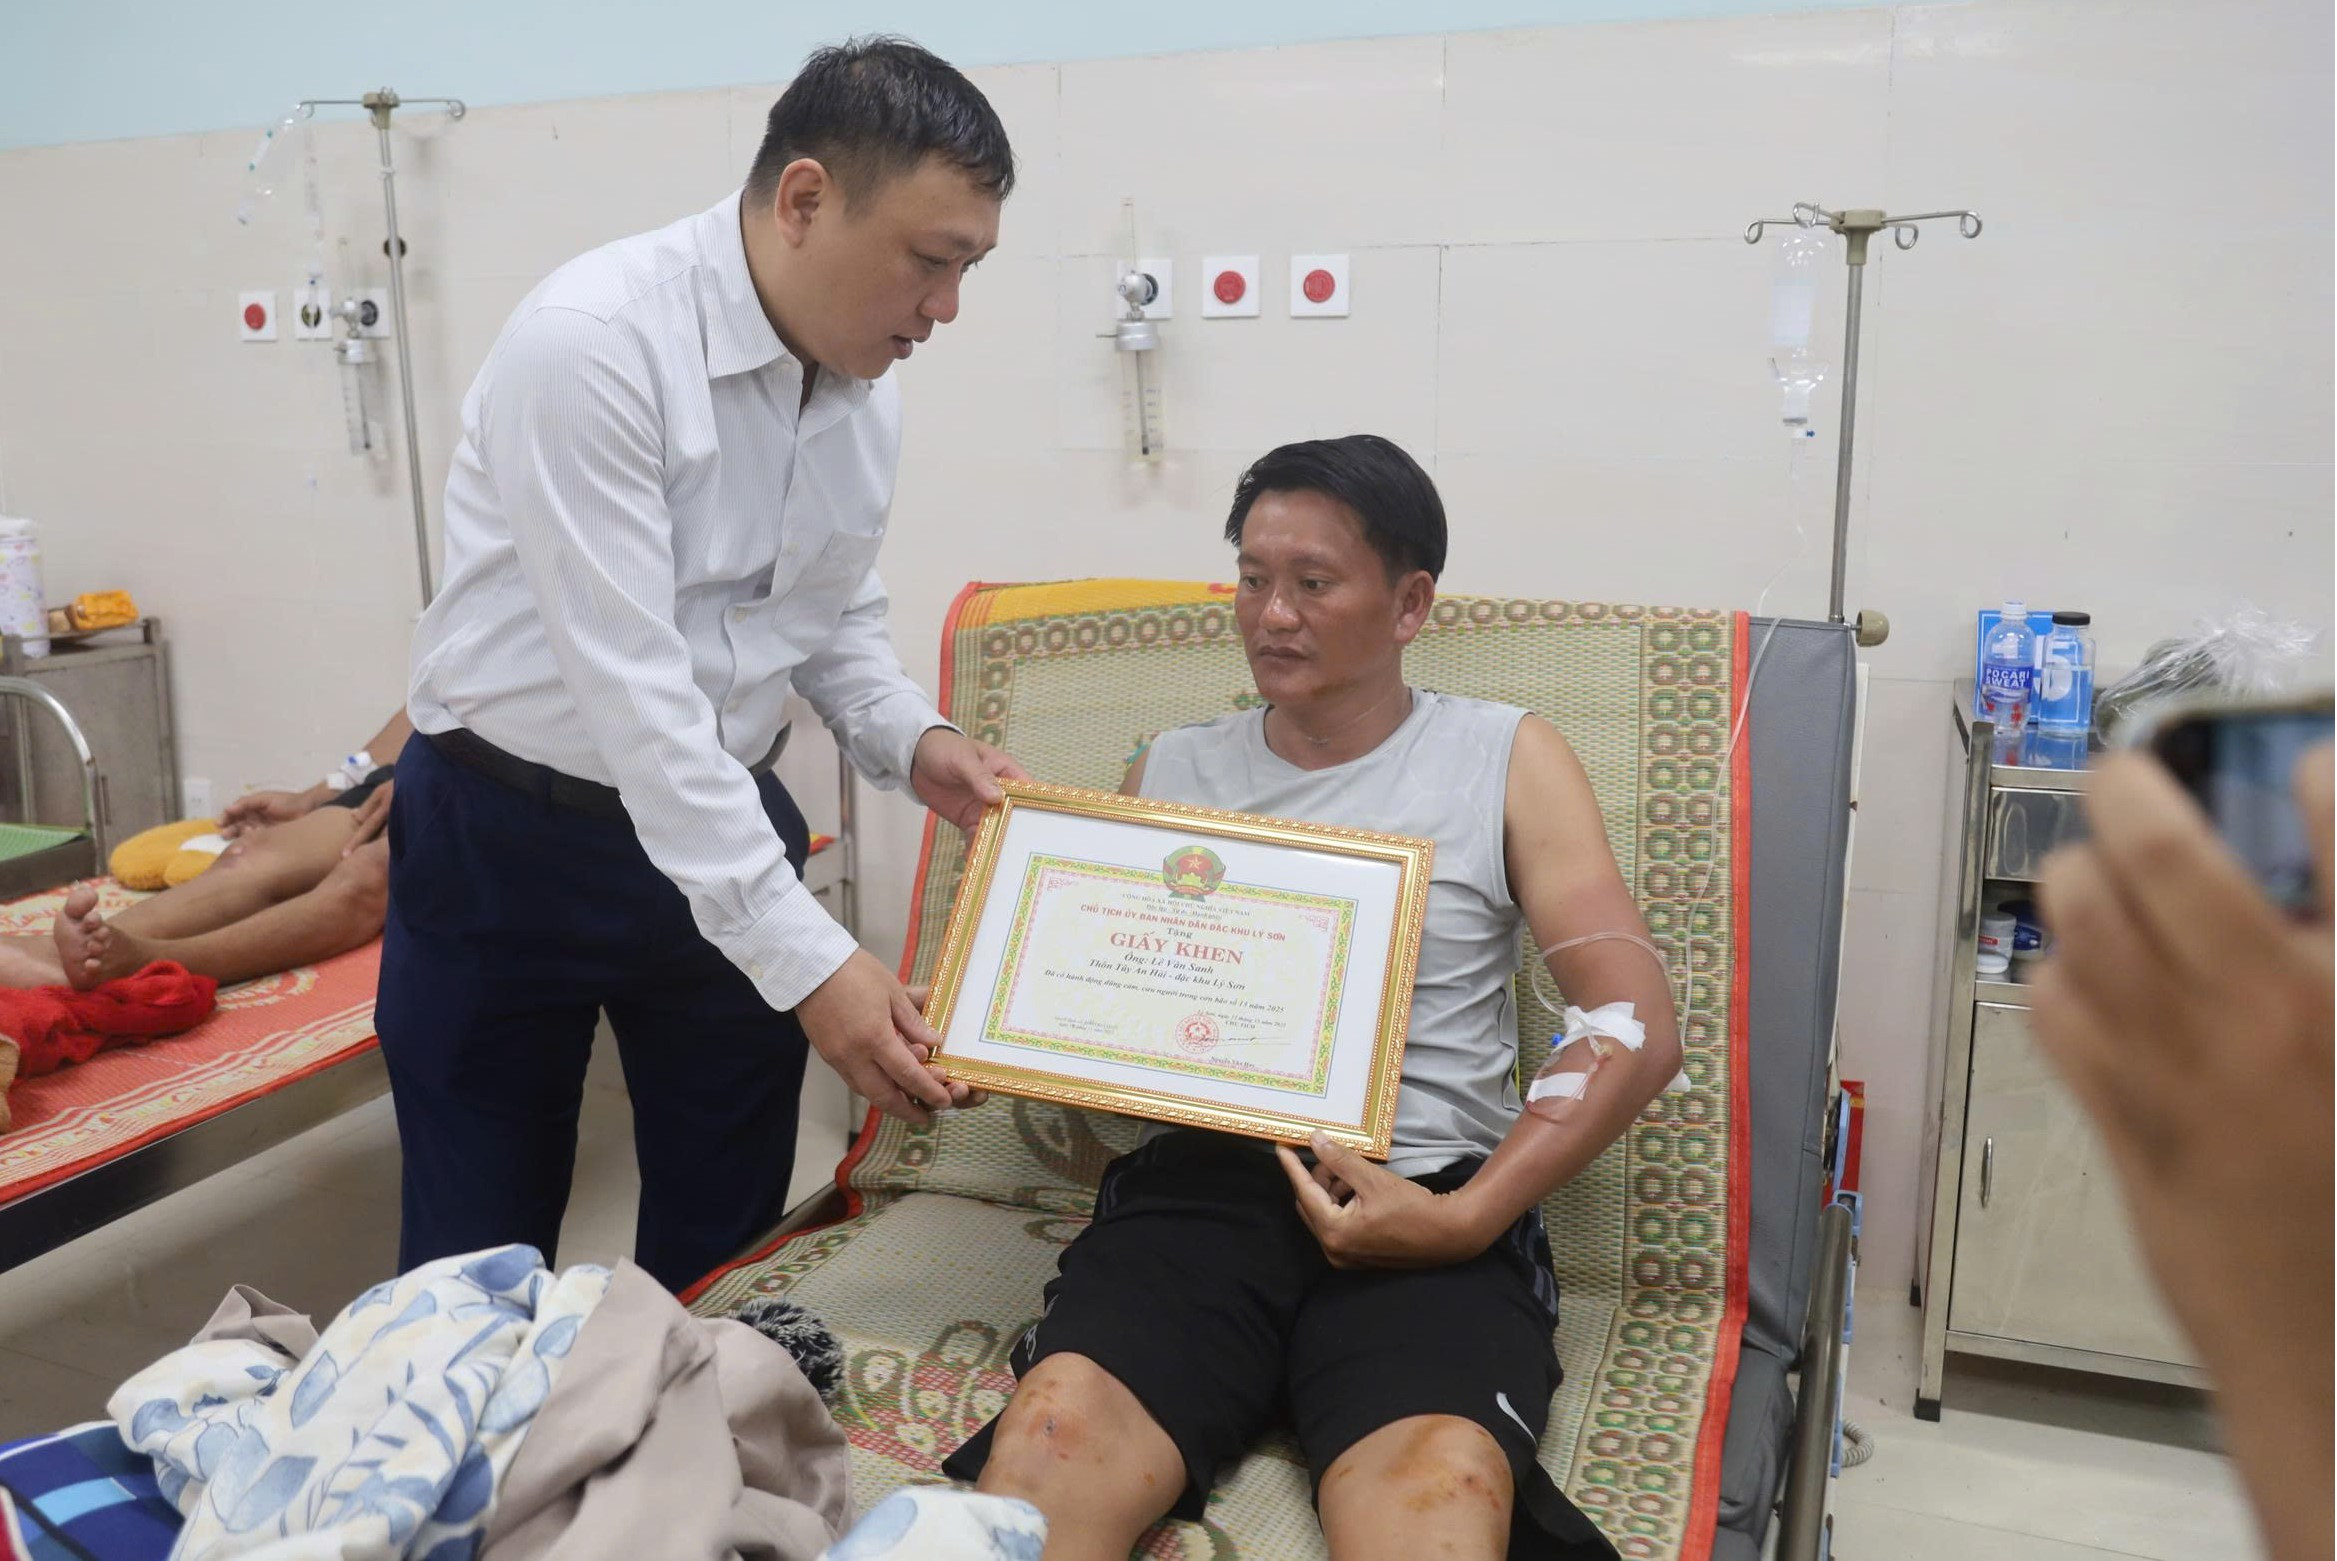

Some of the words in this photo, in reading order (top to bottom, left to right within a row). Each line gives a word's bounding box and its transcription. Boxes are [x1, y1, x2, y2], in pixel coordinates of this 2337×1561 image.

[1986, 668, 2030, 680] POCARI
[1986, 677, 2025, 688] SWEAT
[1080, 902, 1098, 912] CHỦ
[1102, 906, 1122, 917] TỊCH
[1124, 908, 1137, 918] ỦY
[1140, 912, 1158, 922] BAN
[1161, 915, 1185, 926] NHÂN
[1188, 918, 1206, 929] DÂN
[1231, 926, 1250, 936] KHU
[1253, 928, 1264, 938] LÝ
[1266, 931, 1286, 941] SƠN
[1167, 927, 1193, 940] Tặng
[1110, 931, 1168, 953] GIẤY
[1176, 941, 1245, 965] KHEN
[1124, 951, 1149, 965] Ông:
[1188, 962, 1214, 974] Sanh
[1116, 962, 1132, 974] Tây
[1134, 966, 1147, 975] An
[1150, 968, 1166, 978] Hải
[1174, 972, 1191, 983] đặc
[1193, 975, 1210, 985] khu
[1213, 978, 1226, 989] Lý
[1227, 980, 1246, 991] Sơn
